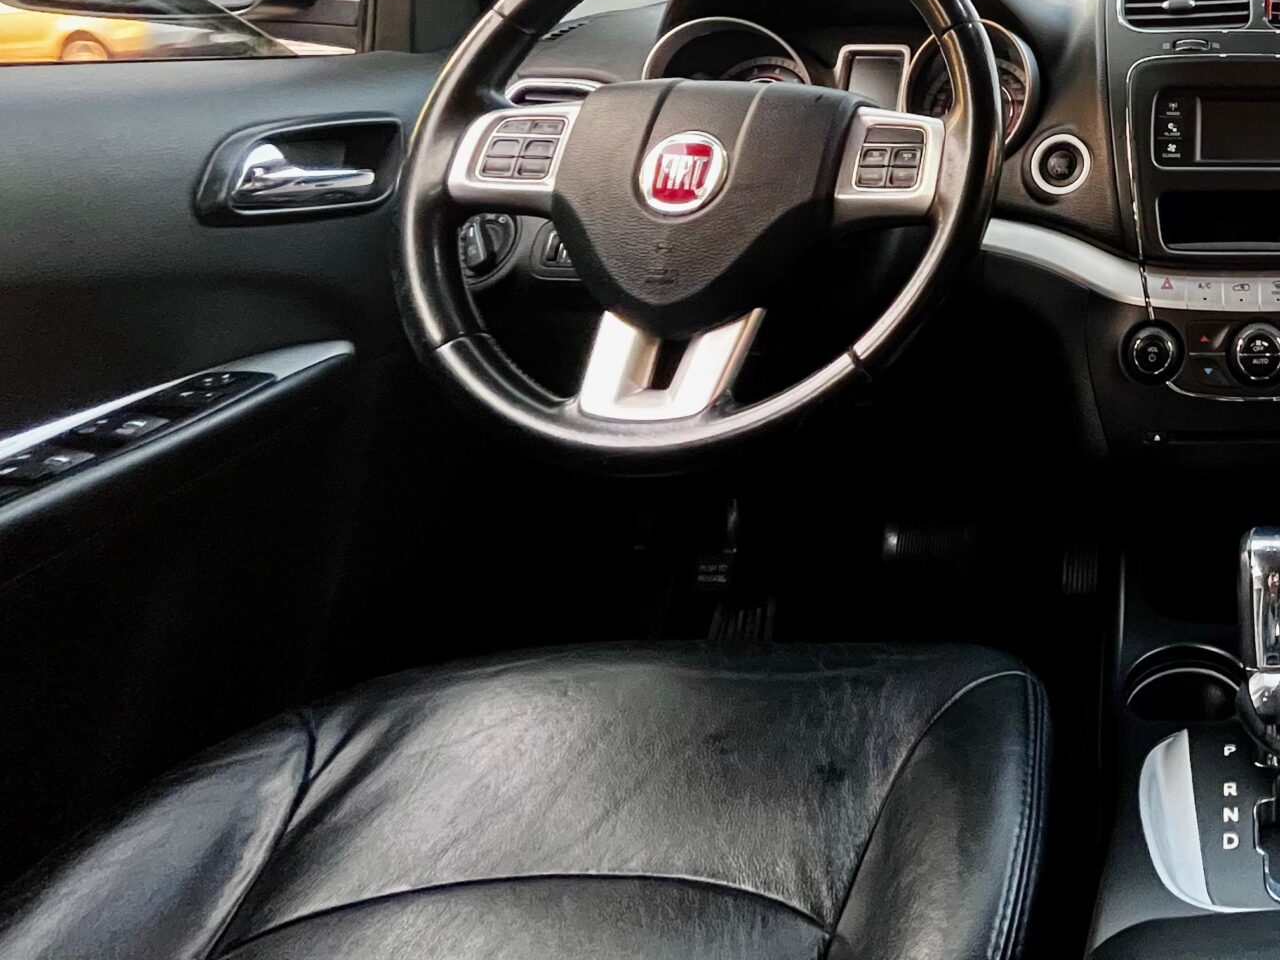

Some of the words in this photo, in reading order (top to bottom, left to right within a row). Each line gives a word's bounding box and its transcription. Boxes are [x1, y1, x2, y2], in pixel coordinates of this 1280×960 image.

[656, 153, 709, 191] FIAT
[1223, 744, 1237, 757] P
[1223, 782, 1238, 796] R
[1223, 807, 1239, 822] N
[1222, 833, 1240, 850] D
